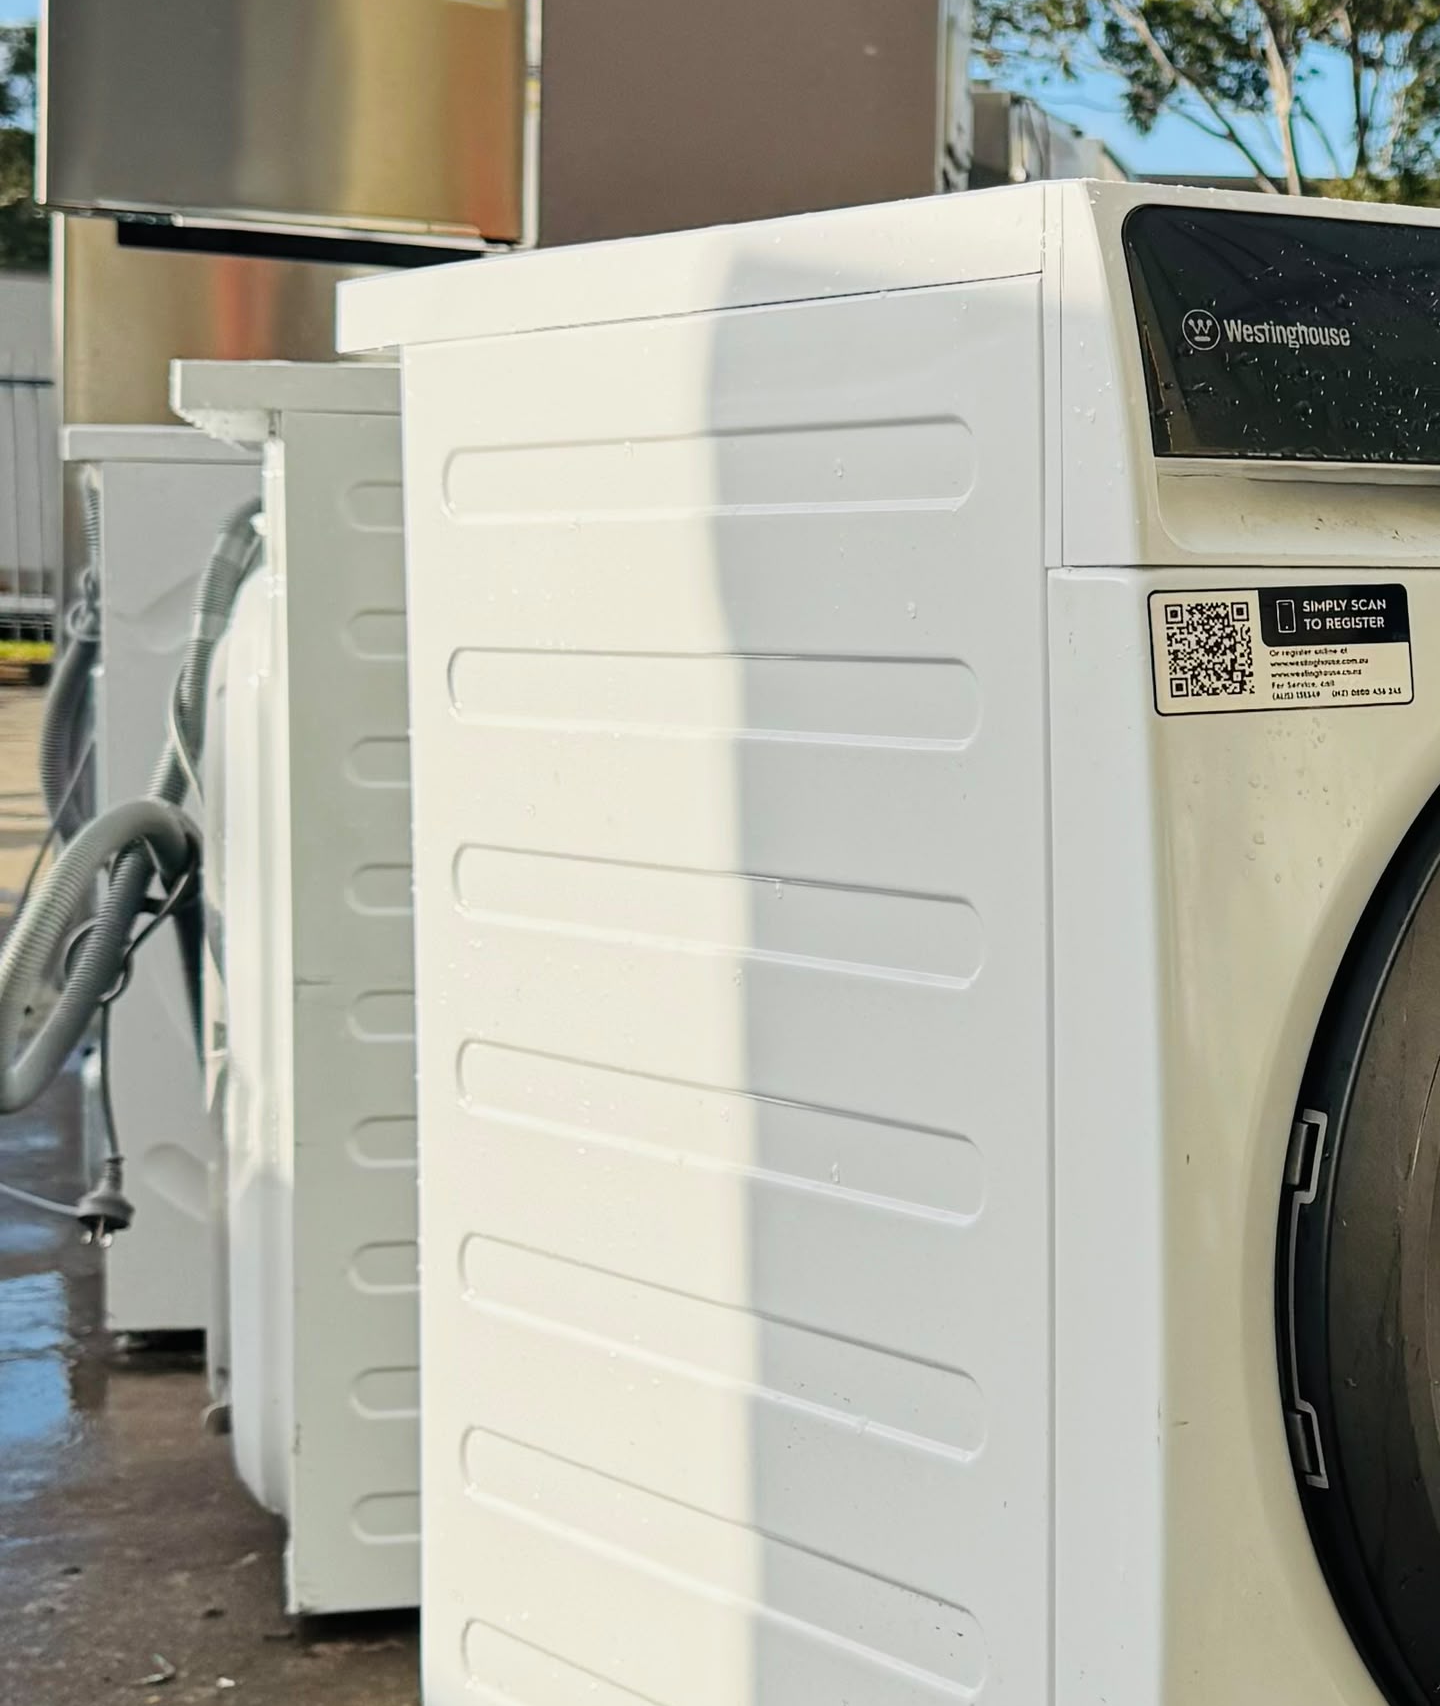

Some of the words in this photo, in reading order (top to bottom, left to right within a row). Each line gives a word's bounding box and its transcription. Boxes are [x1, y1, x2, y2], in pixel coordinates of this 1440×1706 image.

[1223, 318, 1351, 348] Westinghouse
[1302, 599, 1348, 612] SIMPLY
[1351, 598, 1387, 611] SCAN
[1303, 617, 1322, 630] TO
[1326, 616, 1385, 629] REGISTER
[1269, 649, 1279, 657] Or
[1282, 649, 1311, 658] register
[1272, 681, 1284, 689] For
